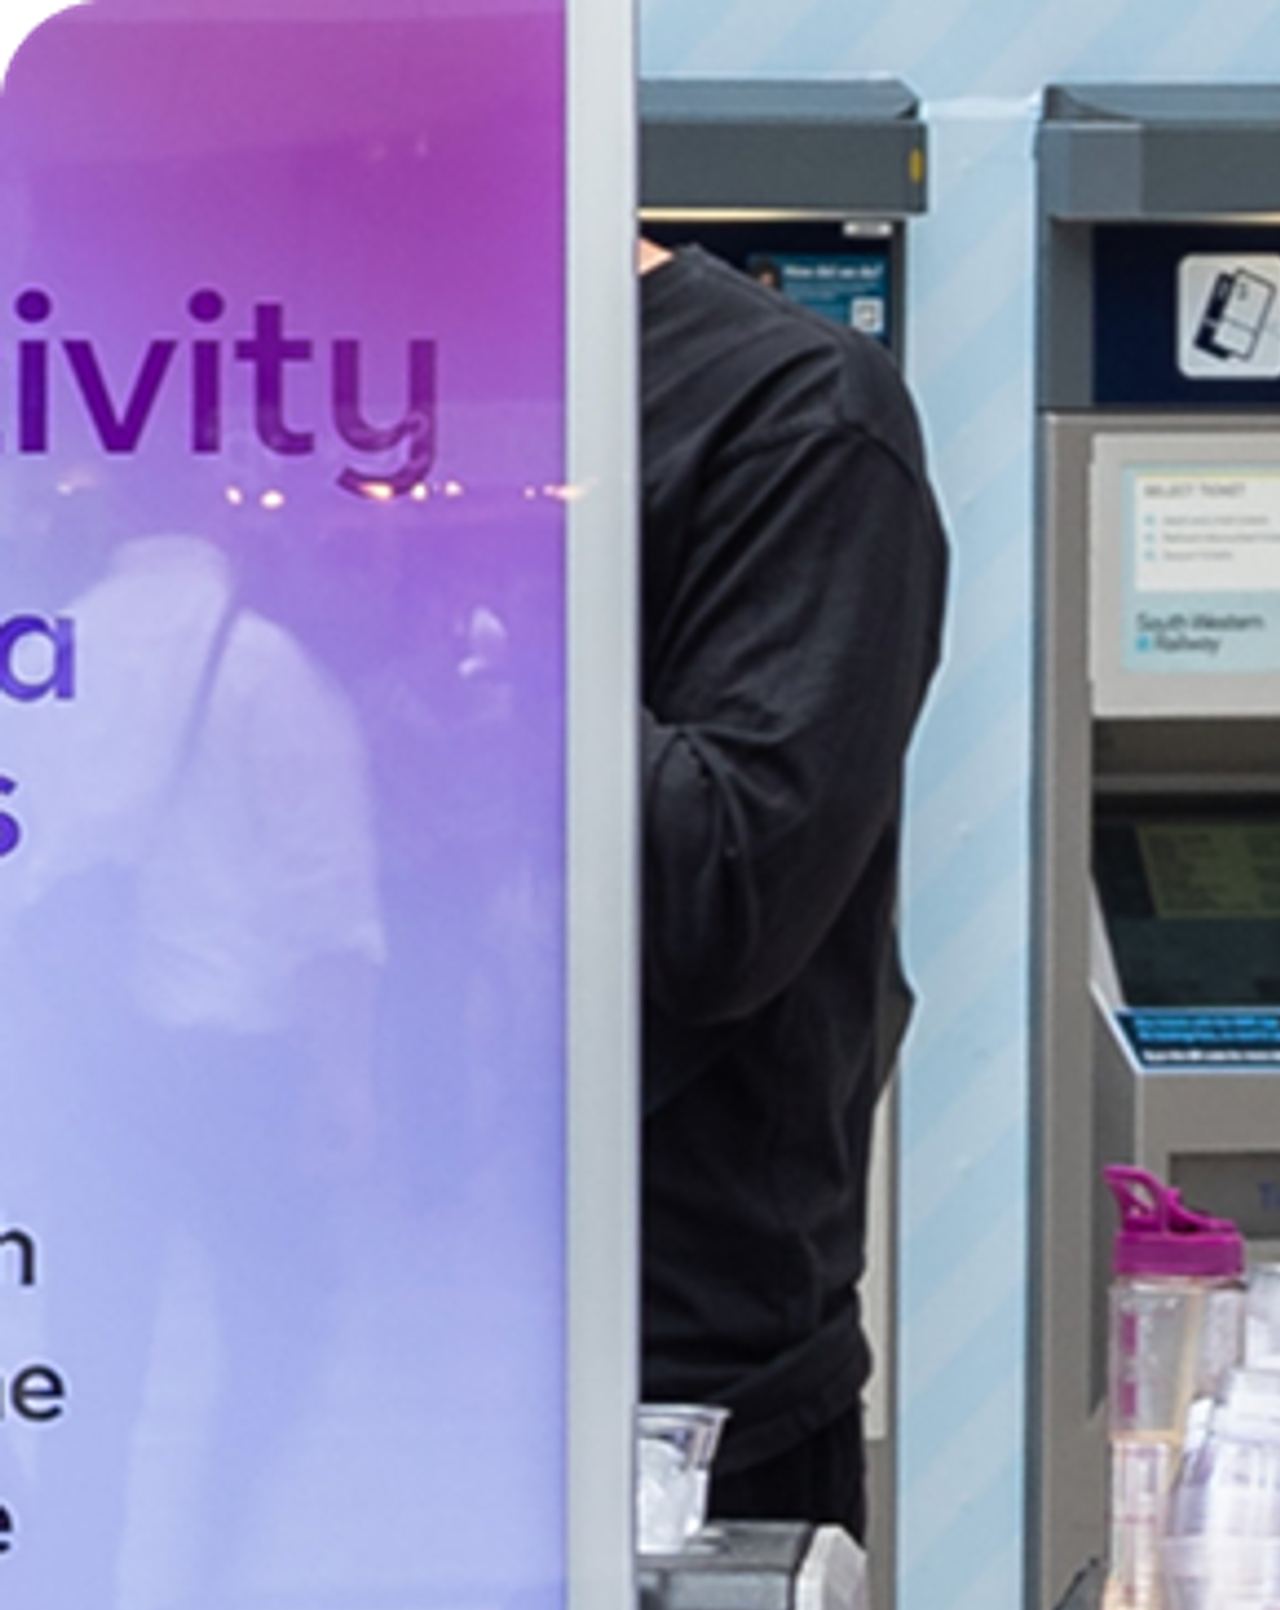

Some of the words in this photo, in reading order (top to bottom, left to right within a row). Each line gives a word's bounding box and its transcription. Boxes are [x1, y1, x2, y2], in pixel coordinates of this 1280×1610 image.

[0, 288, 439, 497] ivity
[1136, 612, 1189, 633] South
[1191, 612, 1265, 631] Western
[1153, 634, 1221, 657] Railway
[0, 1365, 65, 1422] e
